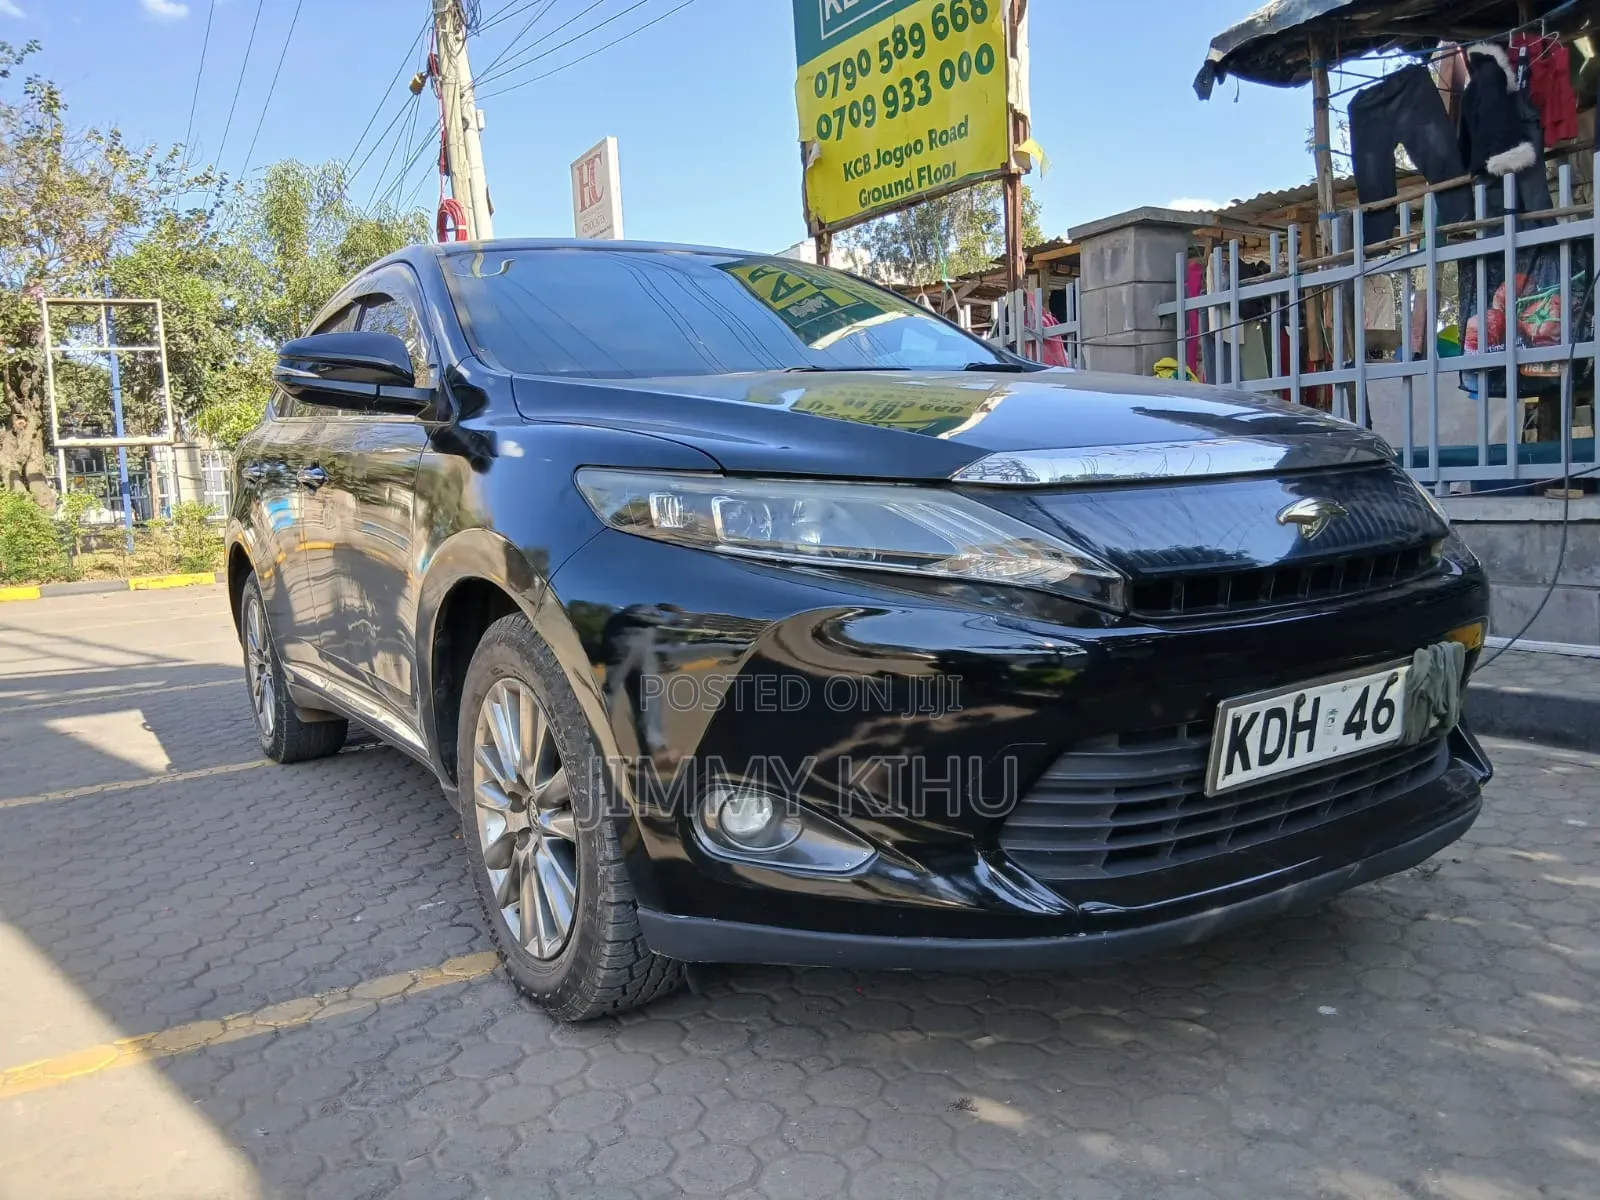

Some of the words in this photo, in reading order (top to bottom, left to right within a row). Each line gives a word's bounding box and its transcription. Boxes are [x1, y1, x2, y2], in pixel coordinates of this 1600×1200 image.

[814, 48, 871, 99] 0790
[878, 22, 925, 75] 589
[931, 0, 988, 42] 668
[816, 94, 876, 141] 0709
[882, 69, 932, 119] 933
[938, 43, 994, 90] 000
[843, 153, 871, 181] KCB
[874, 138, 924, 168] Jogoo
[927, 114, 968, 151] Road
[858, 169, 914, 208] Ground
[917, 160, 956, 188] Floor
[1222, 695, 1321, 778] KDH
[1342, 675, 1397, 741] 46
